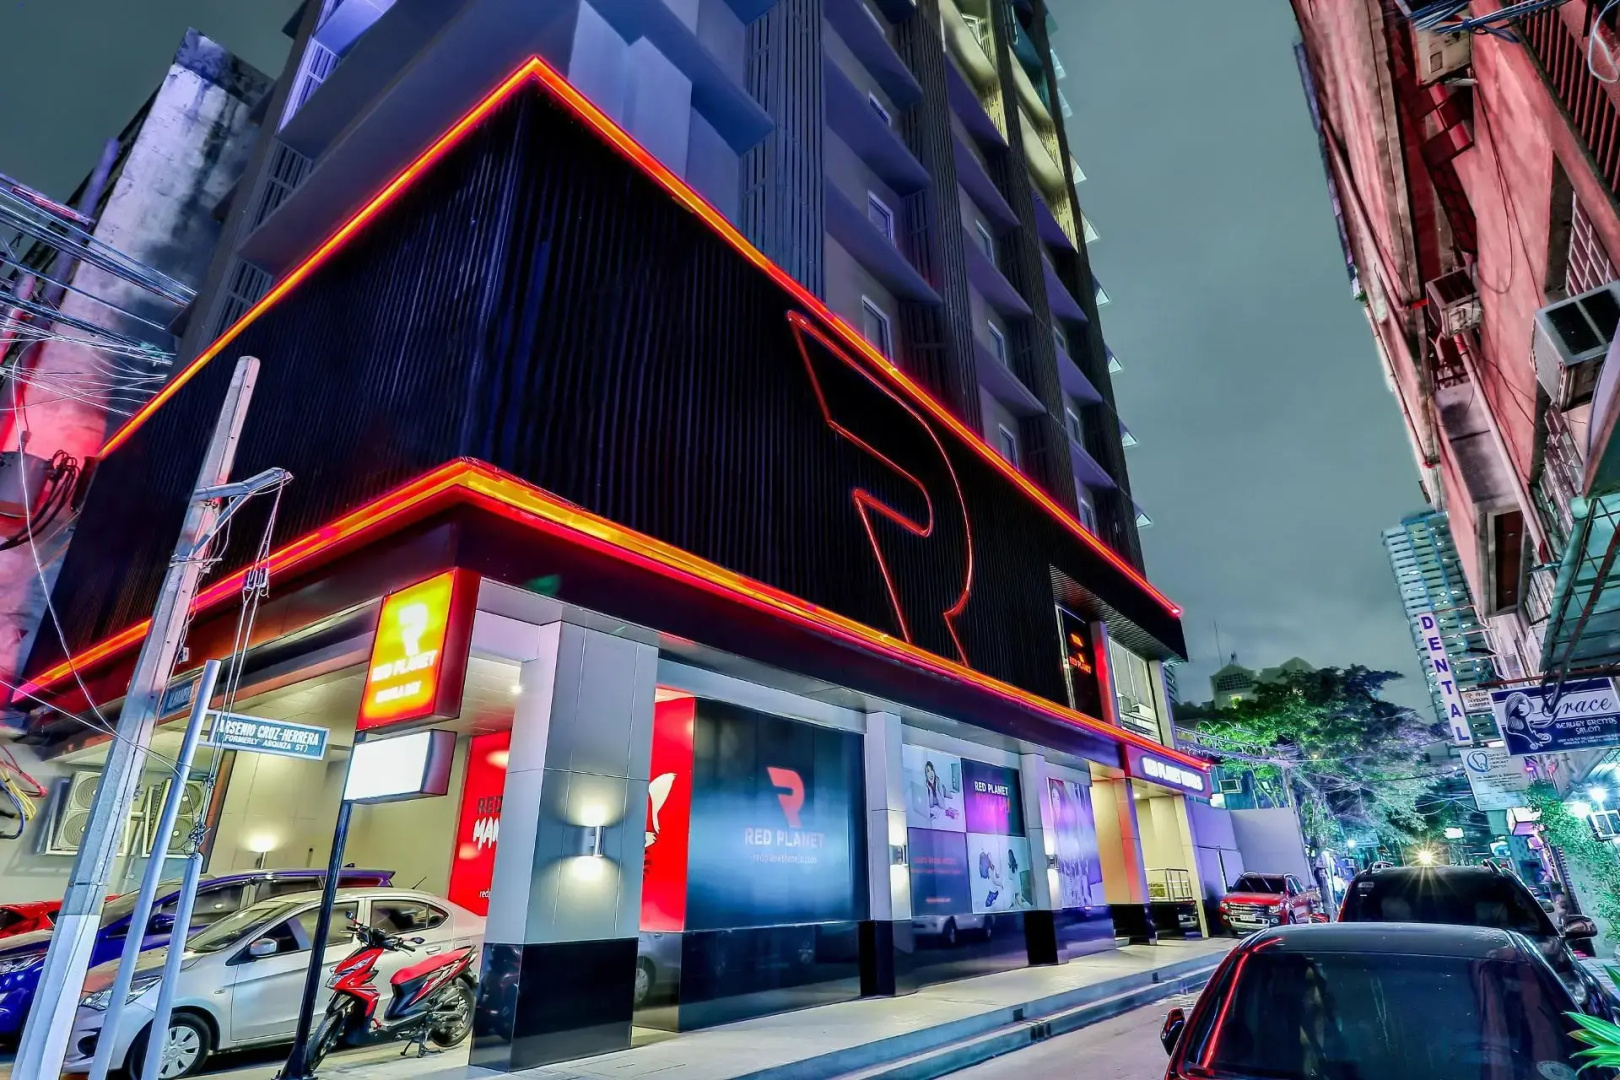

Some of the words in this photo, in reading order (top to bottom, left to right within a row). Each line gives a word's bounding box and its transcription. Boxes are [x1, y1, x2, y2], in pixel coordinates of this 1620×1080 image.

[1421, 616, 1470, 741] DENTAL
[1534, 693, 1612, 727] Grace
[257, 725, 320, 746] CRUZ-HERRERA
[974, 780, 987, 792] RED
[987, 783, 1009, 796] PLANET
[744, 827, 772, 846] RED
[776, 829, 825, 849] PLANET
